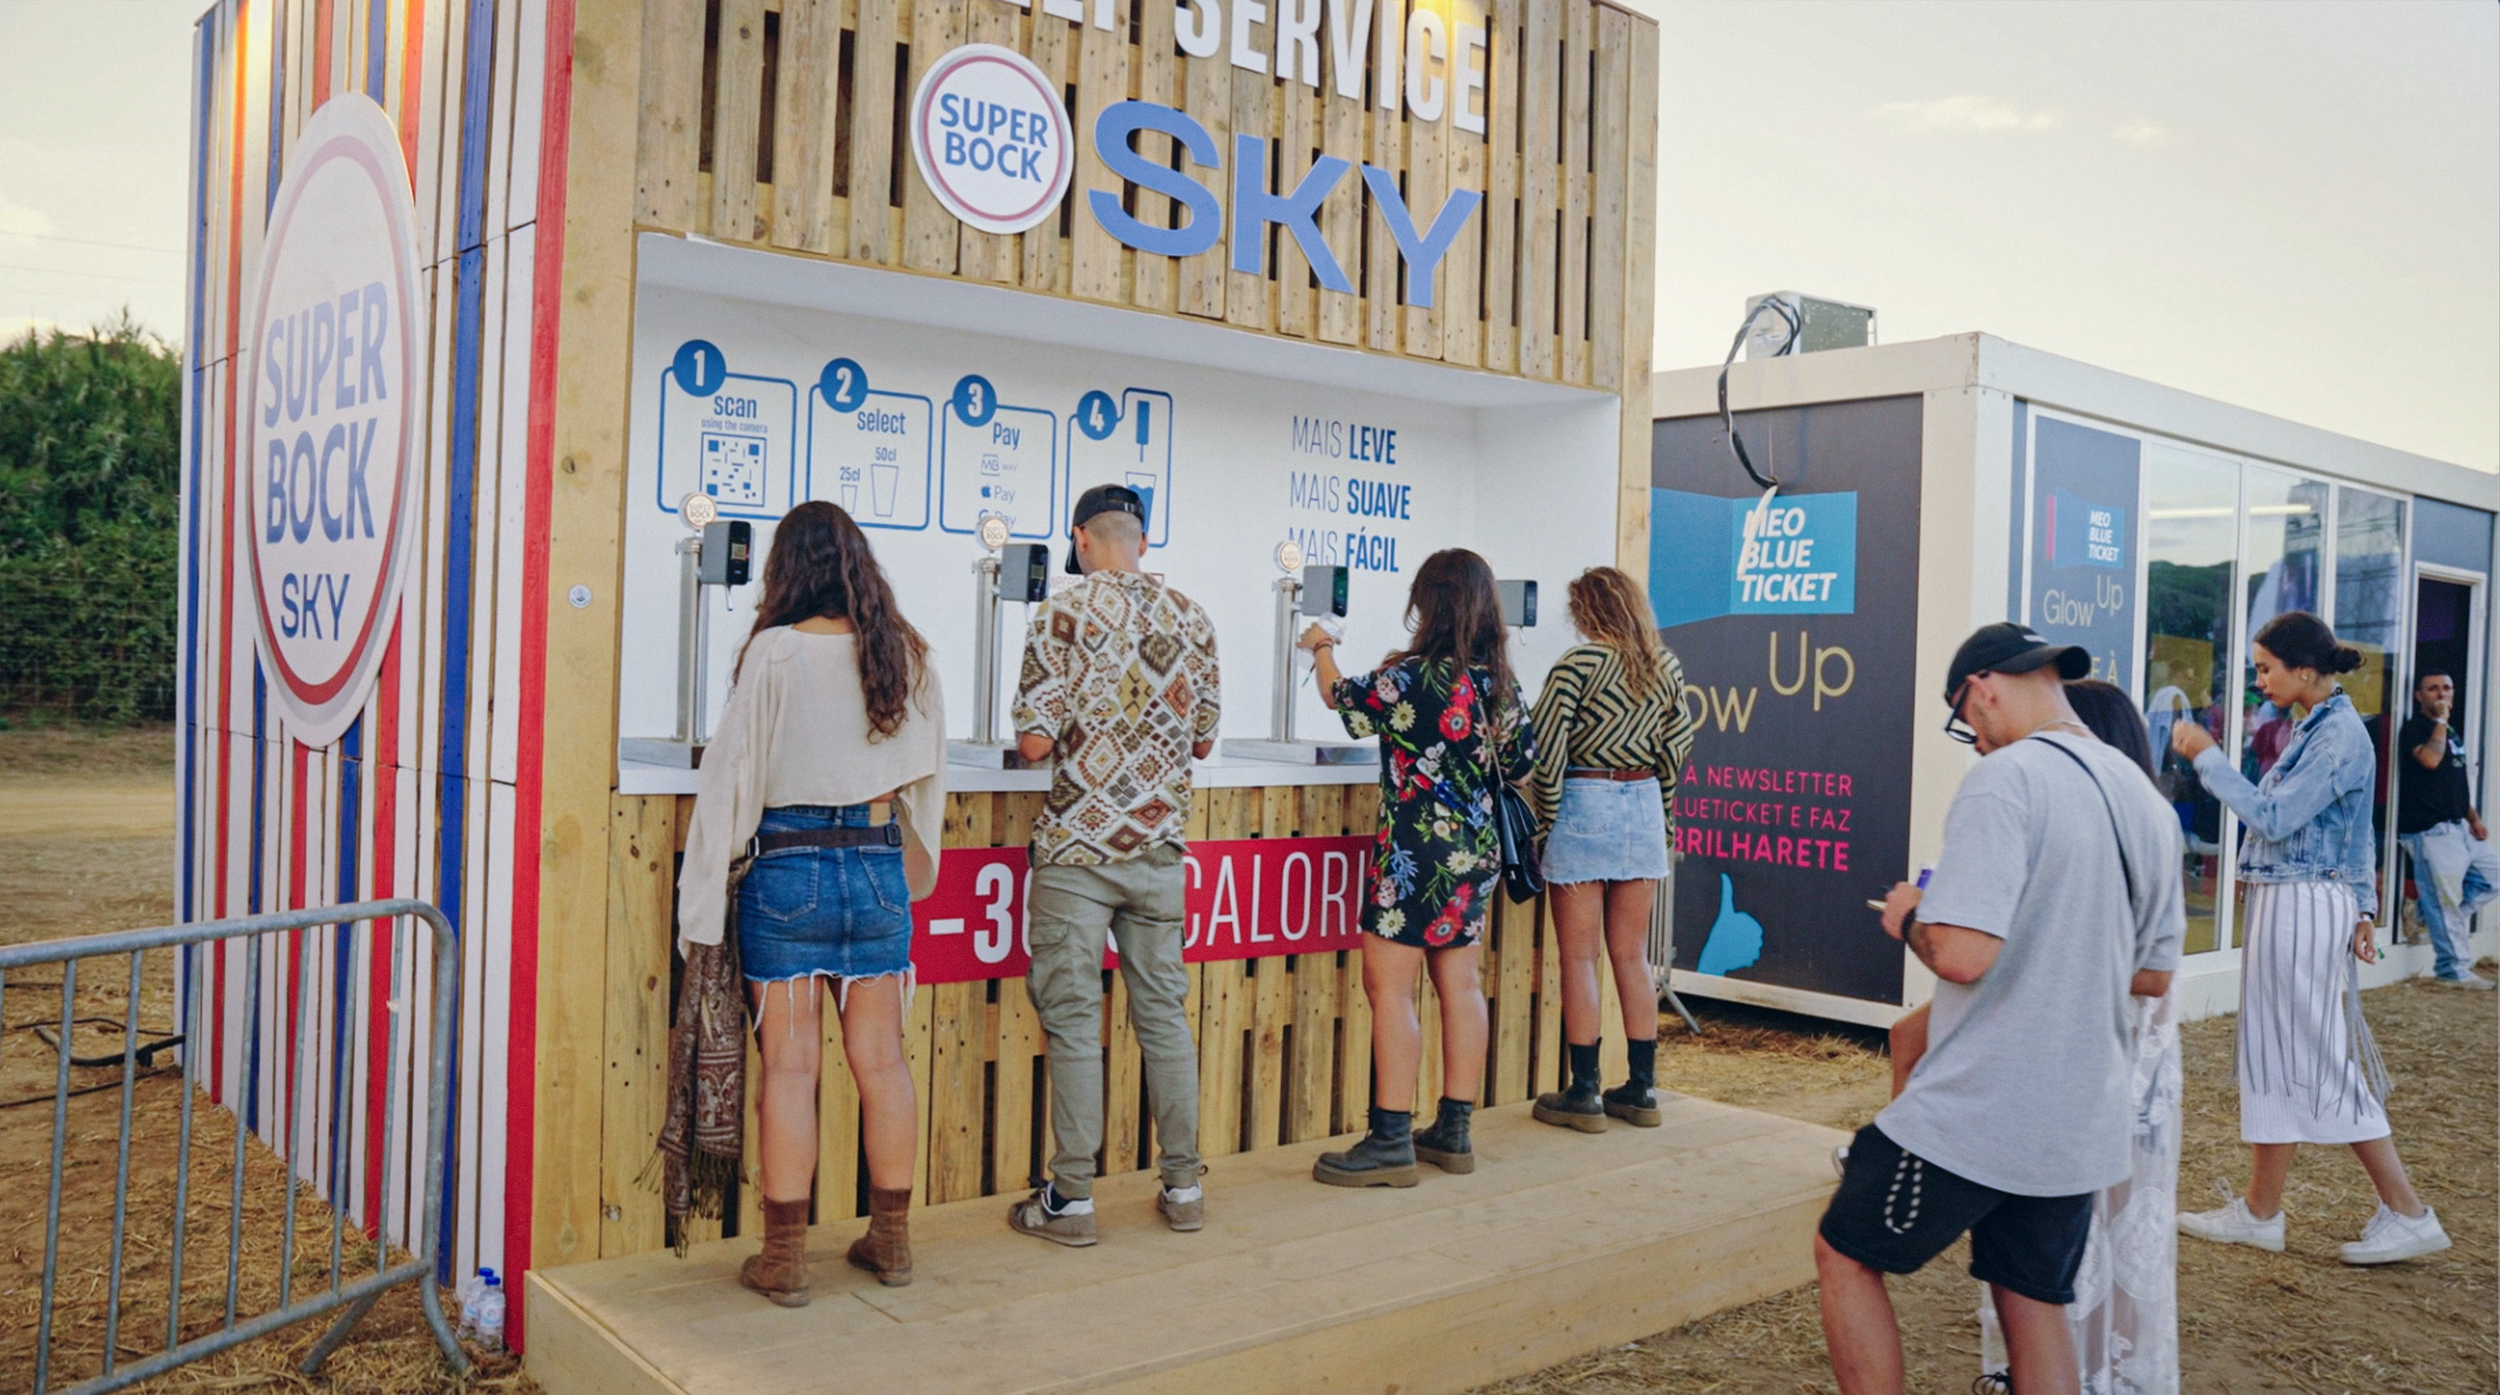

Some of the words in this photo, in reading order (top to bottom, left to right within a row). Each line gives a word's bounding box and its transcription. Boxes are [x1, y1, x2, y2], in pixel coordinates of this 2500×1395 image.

[1174, 0, 1485, 134] SERVICE
[940, 93, 1048, 148] SUPER
[945, 131, 1042, 183] BOCK
[1087, 99, 1483, 308] SKY
[264, 281, 388, 428] SUPER
[693, 350, 705, 387] 1
[835, 367, 852, 403] 2
[968, 383, 983, 418] 3
[714, 396, 757, 418] scan
[857, 409, 906, 435] select
[1089, 398, 1104, 432] 4
[701, 418, 723, 431] using
[725, 420, 737, 431] the
[739, 422, 768, 434] camera
[993, 422, 1020, 450] Pay
[1292, 415, 1342, 458] MAIS
[1350, 424, 1396, 465] LEVE
[875, 447, 897, 462] 50cl
[266, 417, 377, 544] BOCK
[840, 467, 860, 482] 25cl
[994, 485, 1015, 504] Pay
[1290, 471, 1340, 513] MAIS
[1347, 478, 1411, 520] SUAVE
[1742, 507, 1805, 538] MEO
[2089, 510, 2111, 527] MEO
[2089, 527, 2113, 544] BLUE
[1345, 526, 1399, 573] FÁCIL
[1744, 540, 1814, 569] BLUE
[2088, 543, 2120, 561] TICKET
[1741, 572, 1837, 602] TICKET
[2043, 588, 2095, 627] Glow
[2096, 574, 2124, 618] Up
[281, 573, 350, 641] SKY
[1683, 684, 1758, 733] ow
[1769, 631, 1855, 712] Up
[1706, 766, 1852, 797] NEWSLETTER
[1673, 797, 1784, 827] LUETICKET
[1790, 806, 1801, 828] E
[1810, 807, 1852, 832] FAZ
[1674, 826, 1849, 871] BRILHARETE
[929, 862, 1033, 964] -3
[1183, 850, 1374, 949] CALORI
